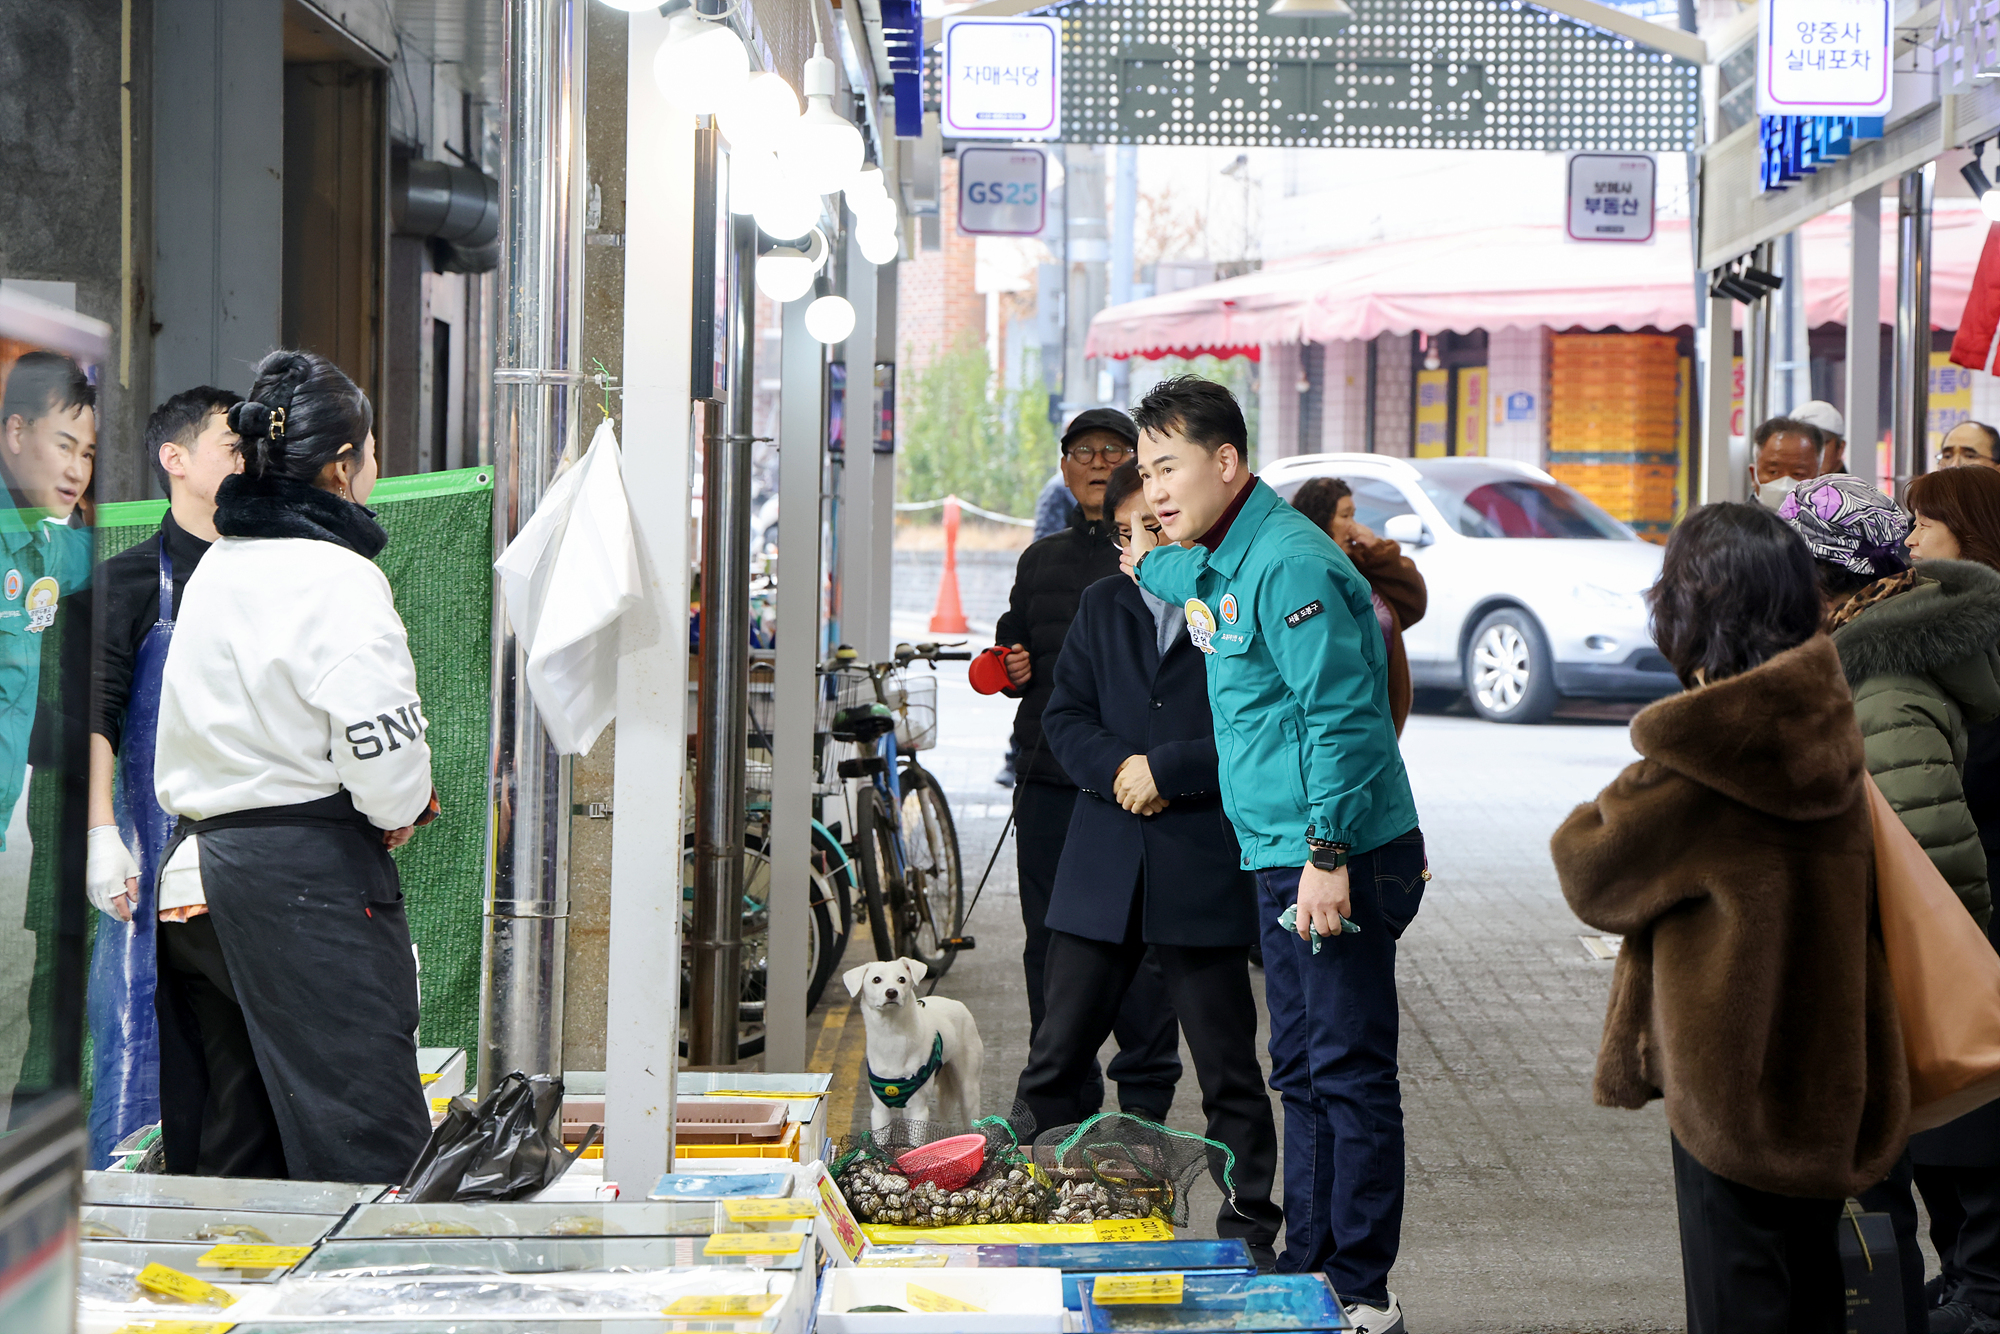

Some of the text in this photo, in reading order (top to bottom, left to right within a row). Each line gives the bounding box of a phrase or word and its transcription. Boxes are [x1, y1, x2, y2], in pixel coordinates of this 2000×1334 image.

[1797, 21, 1861, 44] 양중사
[1785, 49, 1871, 71] 실내포차
[962, 65, 1040, 87] 자매식당
[968, 181, 1038, 206] GS25
[1585, 197, 1638, 216] 부동산
